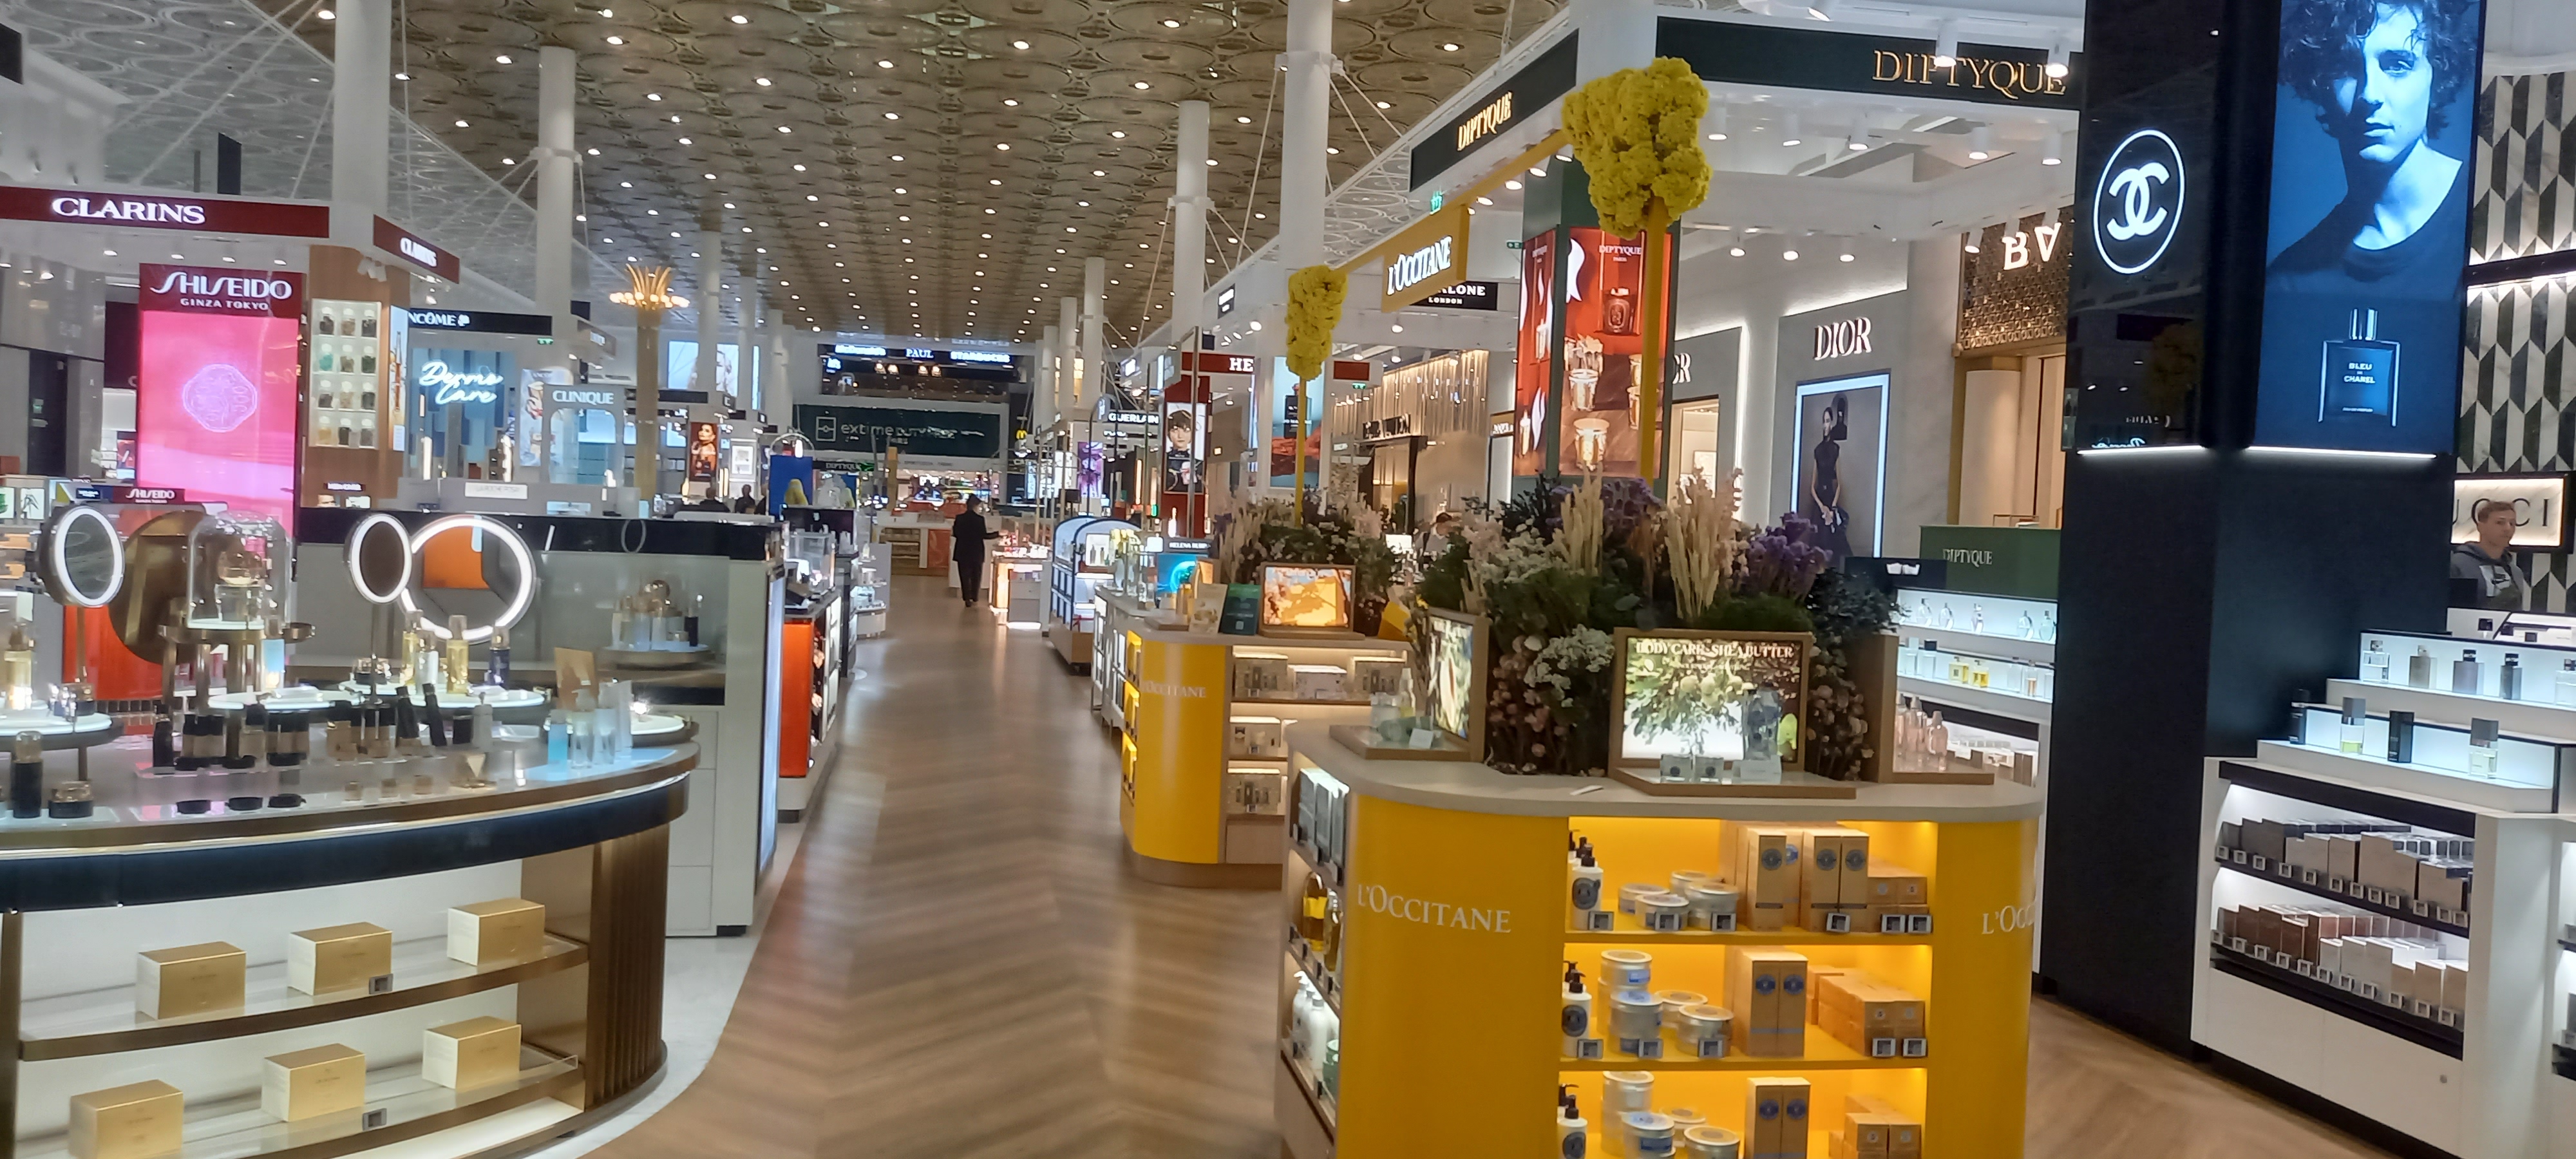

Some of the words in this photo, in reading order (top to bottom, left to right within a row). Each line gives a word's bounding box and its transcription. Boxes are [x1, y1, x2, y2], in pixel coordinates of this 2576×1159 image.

[1872, 50, 2066, 99] DIPTYQUE
[1457, 91, 1512, 151] DIPTYQUE
[52, 197, 206, 224] CLARINS
[1599, 245, 1642, 256] DIPTYQUE
[1387, 236, 1452, 296] L'OCCITANE
[149, 272, 292, 299] SHISEIDO
[180, 298, 222, 308] GINZA
[225, 300, 269, 310] TOKYO
[1428, 296, 1463, 305] LONDON
[1814, 317, 1872, 361] DIOR
[906, 348, 934, 359] PAUL
[419, 361, 504, 387] Derma
[1229, 357, 1254, 372] HE
[435, 384, 497, 405] Care
[553, 390, 614, 405] CLINIQUE
[841, 422, 893, 436] extime
[126, 488, 175, 500] SHISEIDO
[1942, 549, 1993, 568] DIPTYQUE
[1358, 883, 1511, 933] L'OCCITANE
